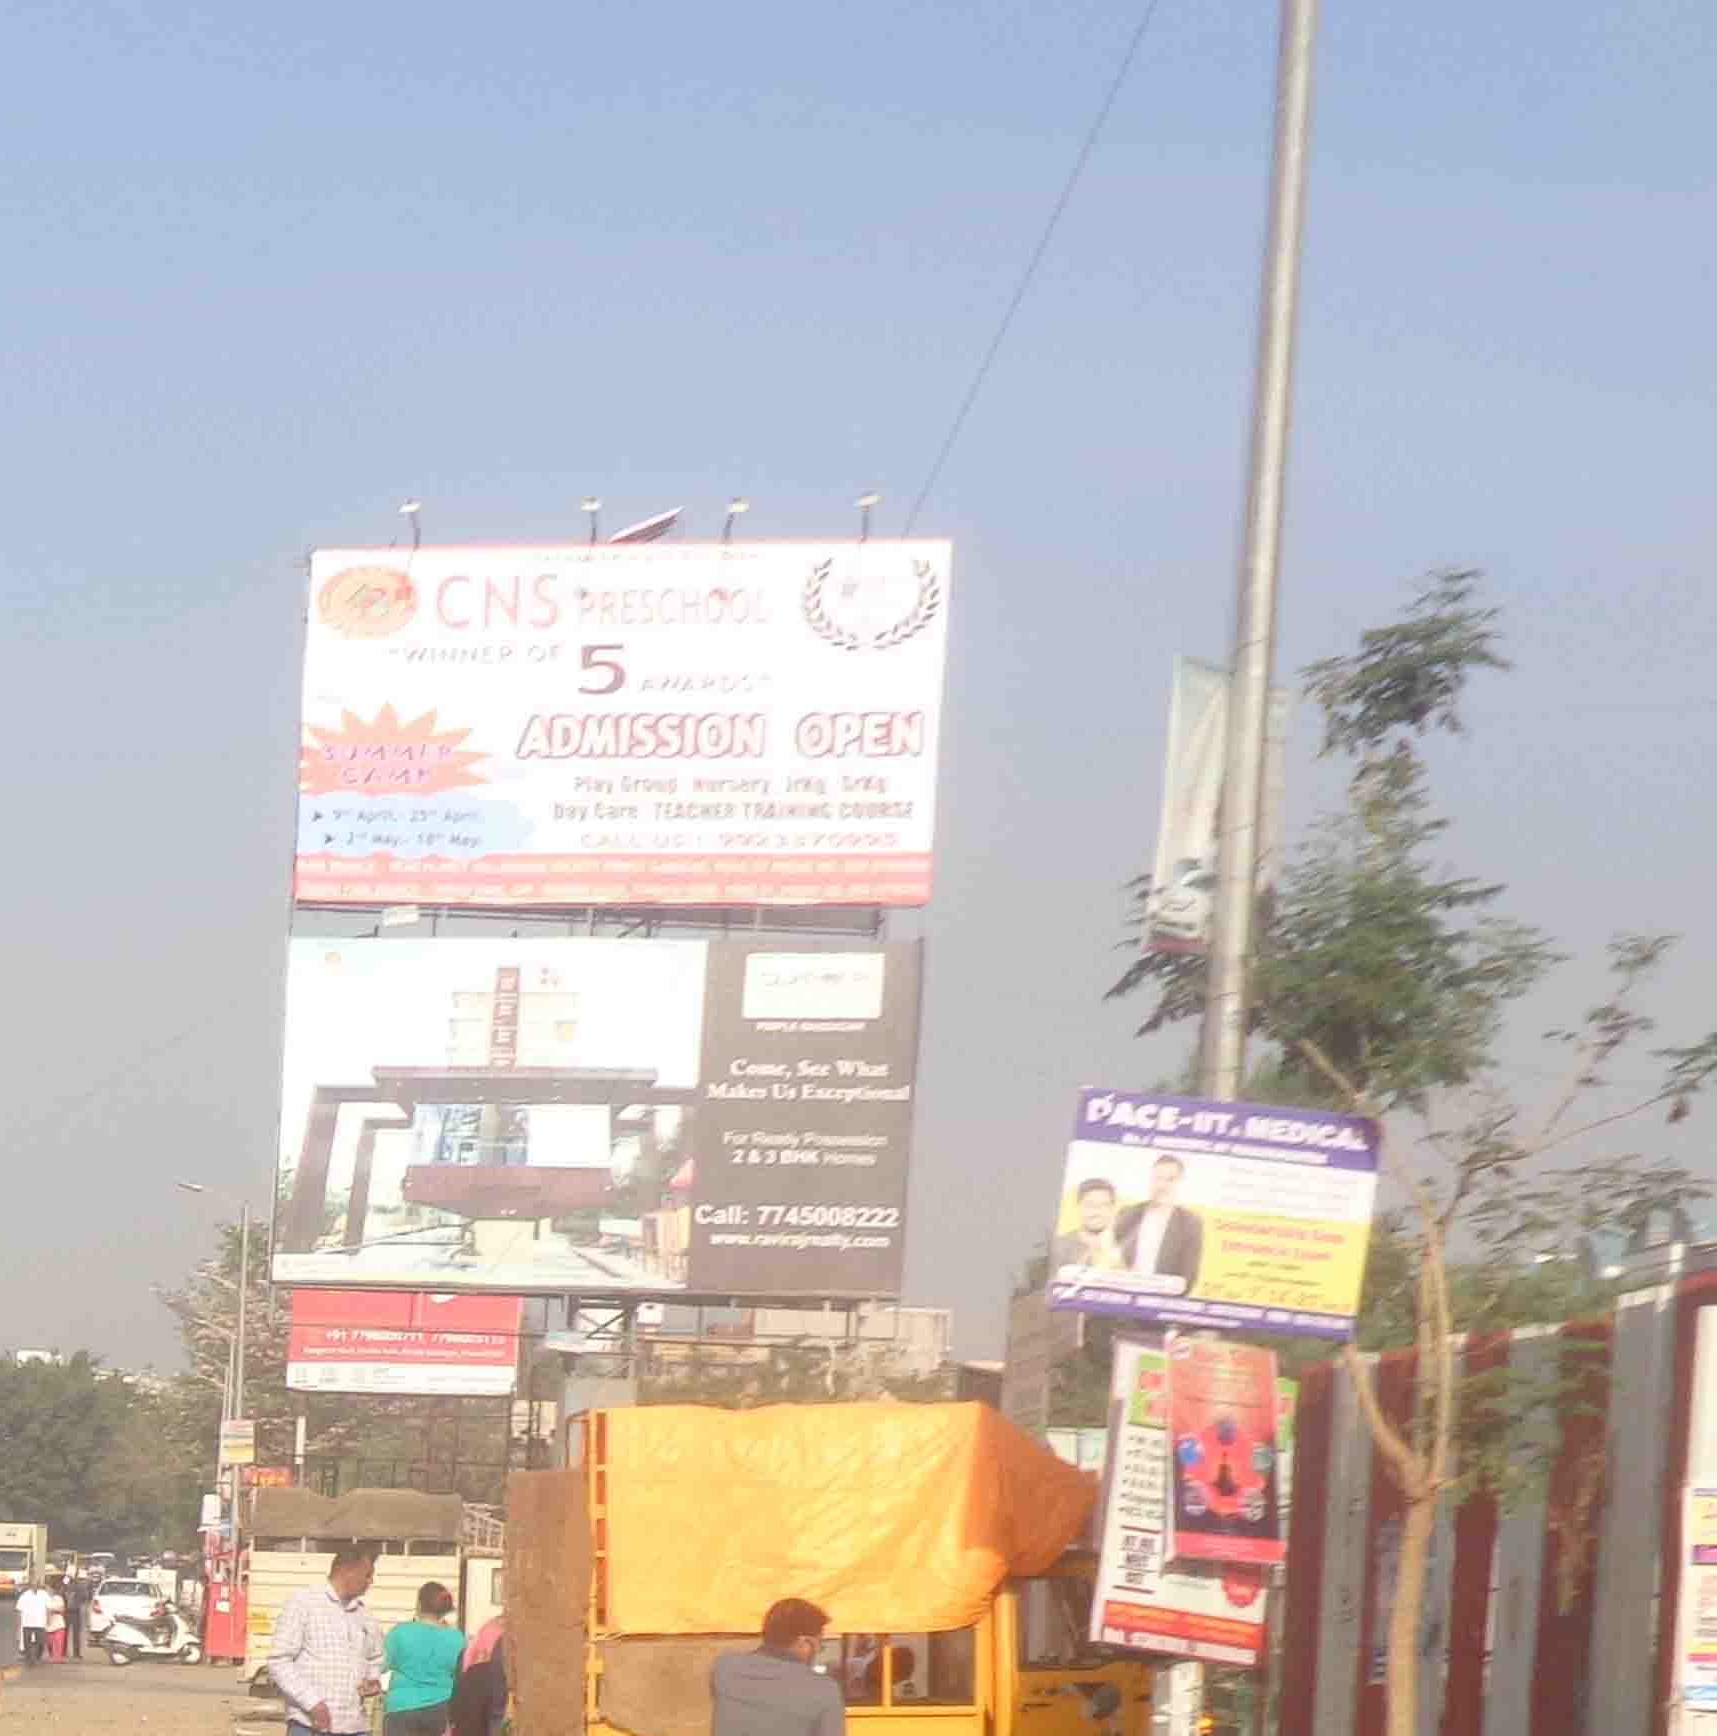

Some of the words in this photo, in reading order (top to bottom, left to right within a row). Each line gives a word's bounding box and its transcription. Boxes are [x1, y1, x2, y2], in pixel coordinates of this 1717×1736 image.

[436, 575, 562, 631] CNS
[576, 643, 629, 696] 5
[514, 712, 767, 760] ADMISSION
[796, 709, 925, 759] OPEN
[706, 1082, 768, 1100] Makes
[801, 1083, 911, 1104] Exceptional
[779, 1149, 821, 1165] BHK
[695, 1205, 750, 1226] Call:
[756, 1206, 900, 1228] 7745008222
